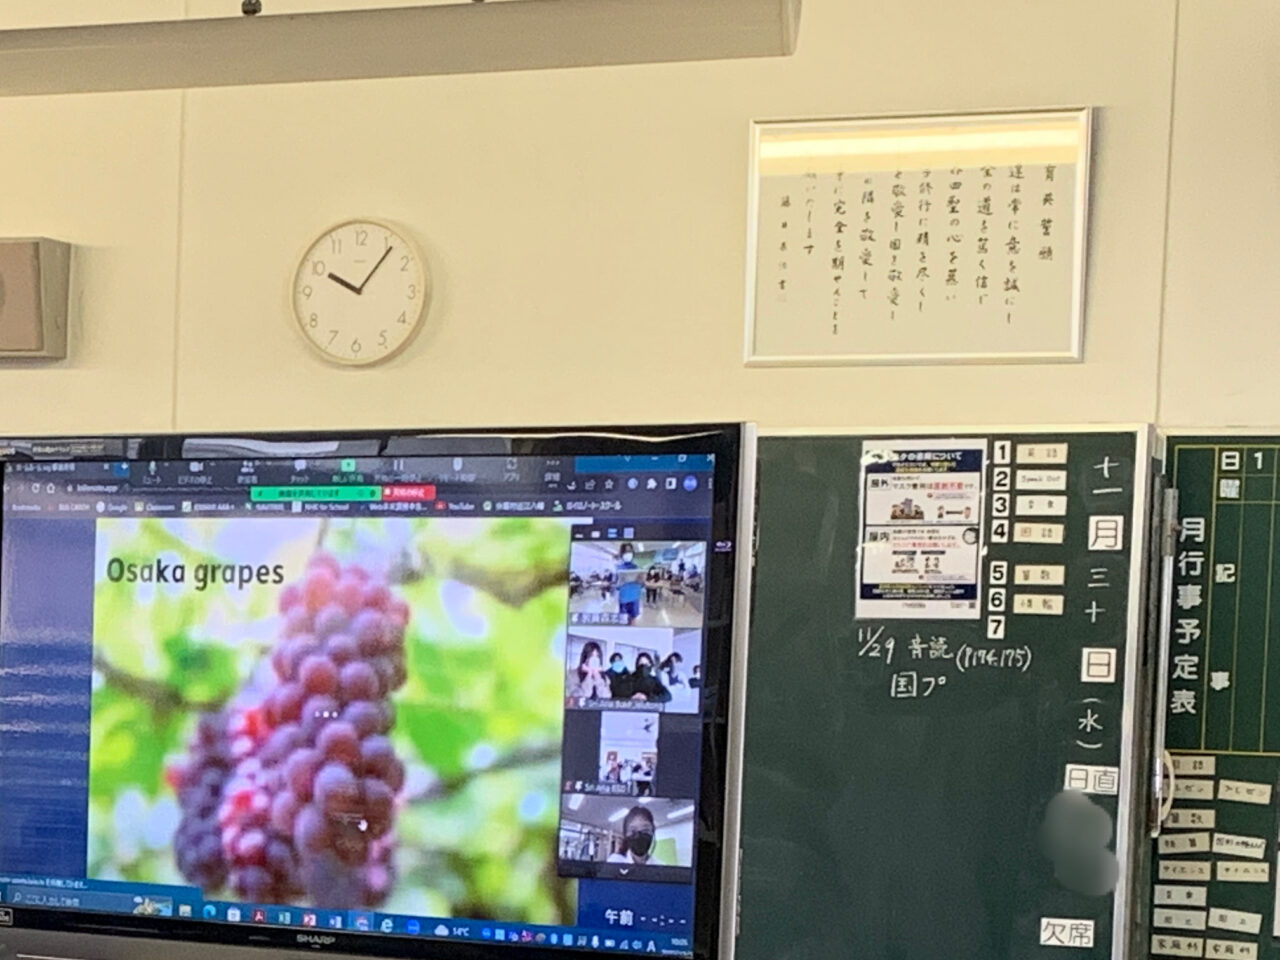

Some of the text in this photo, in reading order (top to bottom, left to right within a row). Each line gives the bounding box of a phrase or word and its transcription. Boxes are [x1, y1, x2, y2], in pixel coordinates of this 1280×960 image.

[355, 230, 368, 246] 12
[331, 239, 342, 254] 11
[311, 260, 326, 276] 10
[400, 255, 410, 272] 2
[302, 285, 312, 299] 9
[407, 284, 417, 300] 3
[309, 312, 318, 328] 8
[397, 310, 407, 324] 4
[329, 330, 339, 345] 7
[350, 338, 362, 353] 6
[378, 330, 388, 346] 5
[999, 444, 1005, 460] 1
[1220, 450, 1264, 471] 日 1
[996, 471, 1008, 487] 2
[995, 496, 1007, 513] 3
[993, 523, 1005, 539] 4
[106, 557, 285, 592] Osaka grapes
[992, 565, 1004, 581] 5
[991, 591, 1003, 608] 6
[1170, 517, 1206, 715] 月行事予定表
[990, 619, 1002, 635] 7
[858, 625, 896, 664] 11/29
[908, 633, 955, 660] 音読
[890, 671, 947, 698] 国プ
[1068, 769, 1119, 792] 日直
[605, 908, 634, 927] 午前
[296, 934, 337, 944] SHARP
[1042, 920, 1093, 948] 欠席
